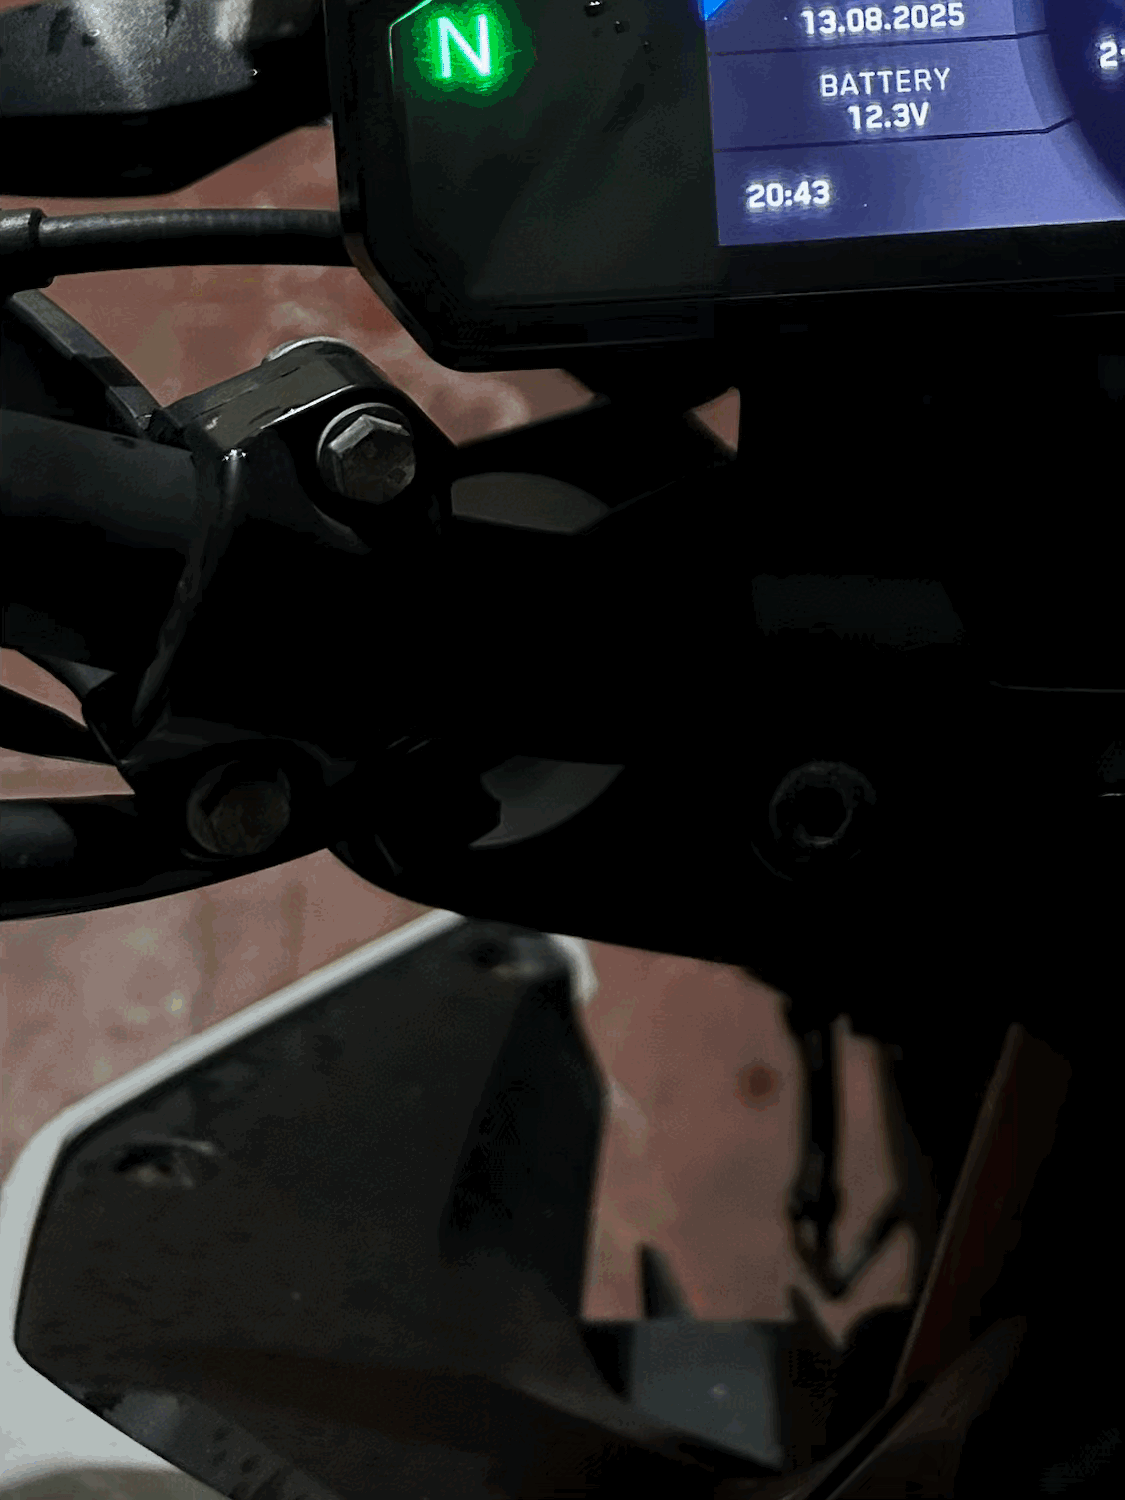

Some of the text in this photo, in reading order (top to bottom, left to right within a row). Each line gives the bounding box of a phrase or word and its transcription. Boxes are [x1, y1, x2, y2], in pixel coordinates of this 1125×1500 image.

[801, 1, 965, 35] 13.08.2025
[438, 14, 491, 78] N
[1100, 40, 1118, 69] 2
[821, 68, 950, 97] BATTERY
[848, 102, 929, 131] 12.3V
[746, 180, 831, 210] 20:43
